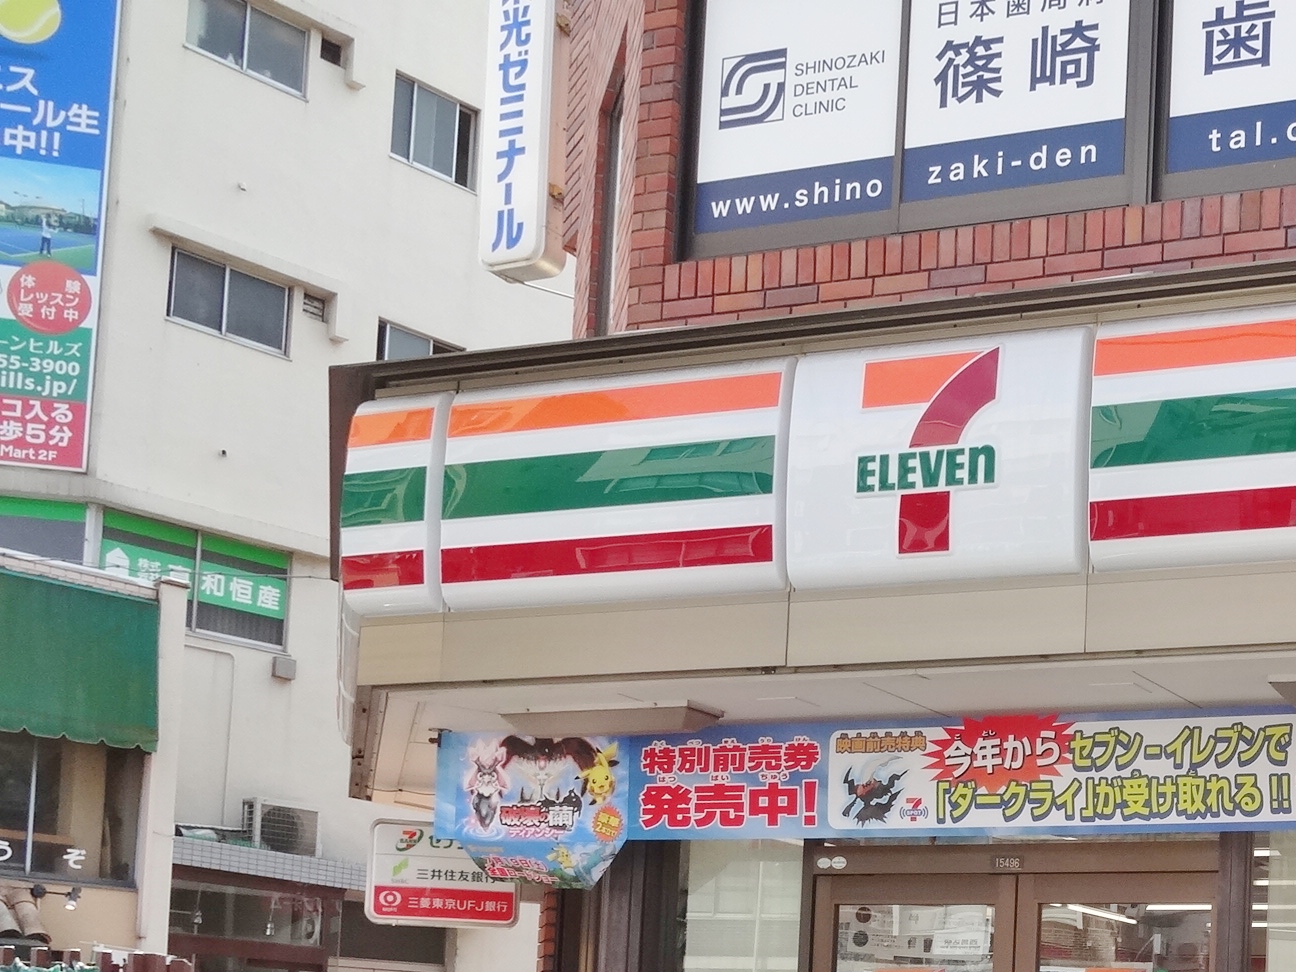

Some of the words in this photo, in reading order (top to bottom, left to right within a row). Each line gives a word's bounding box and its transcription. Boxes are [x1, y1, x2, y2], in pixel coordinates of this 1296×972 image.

[794, 50, 886, 77] SHINOZAKI
[934, 20, 1100, 109] 篠崎
[793, 75, 859, 98] DENTAL
[792, 98, 847, 118] CLINIC
[491, 0, 532, 252] 光ゼミナール
[710, 176, 883, 218] www.shino
[928, 141, 1098, 184] zaki-den
[20, 289, 79, 307] レッスン
[18, 303, 79, 322] 受付中
[38, 450, 57, 460] 2F
[642, 742, 820, 774] 特別前売券
[943, 730, 1061, 778] 今年から
[641, 781, 818, 829] 発売中!
[407, 897, 508, 913] 三菱東京UFJ銀行
